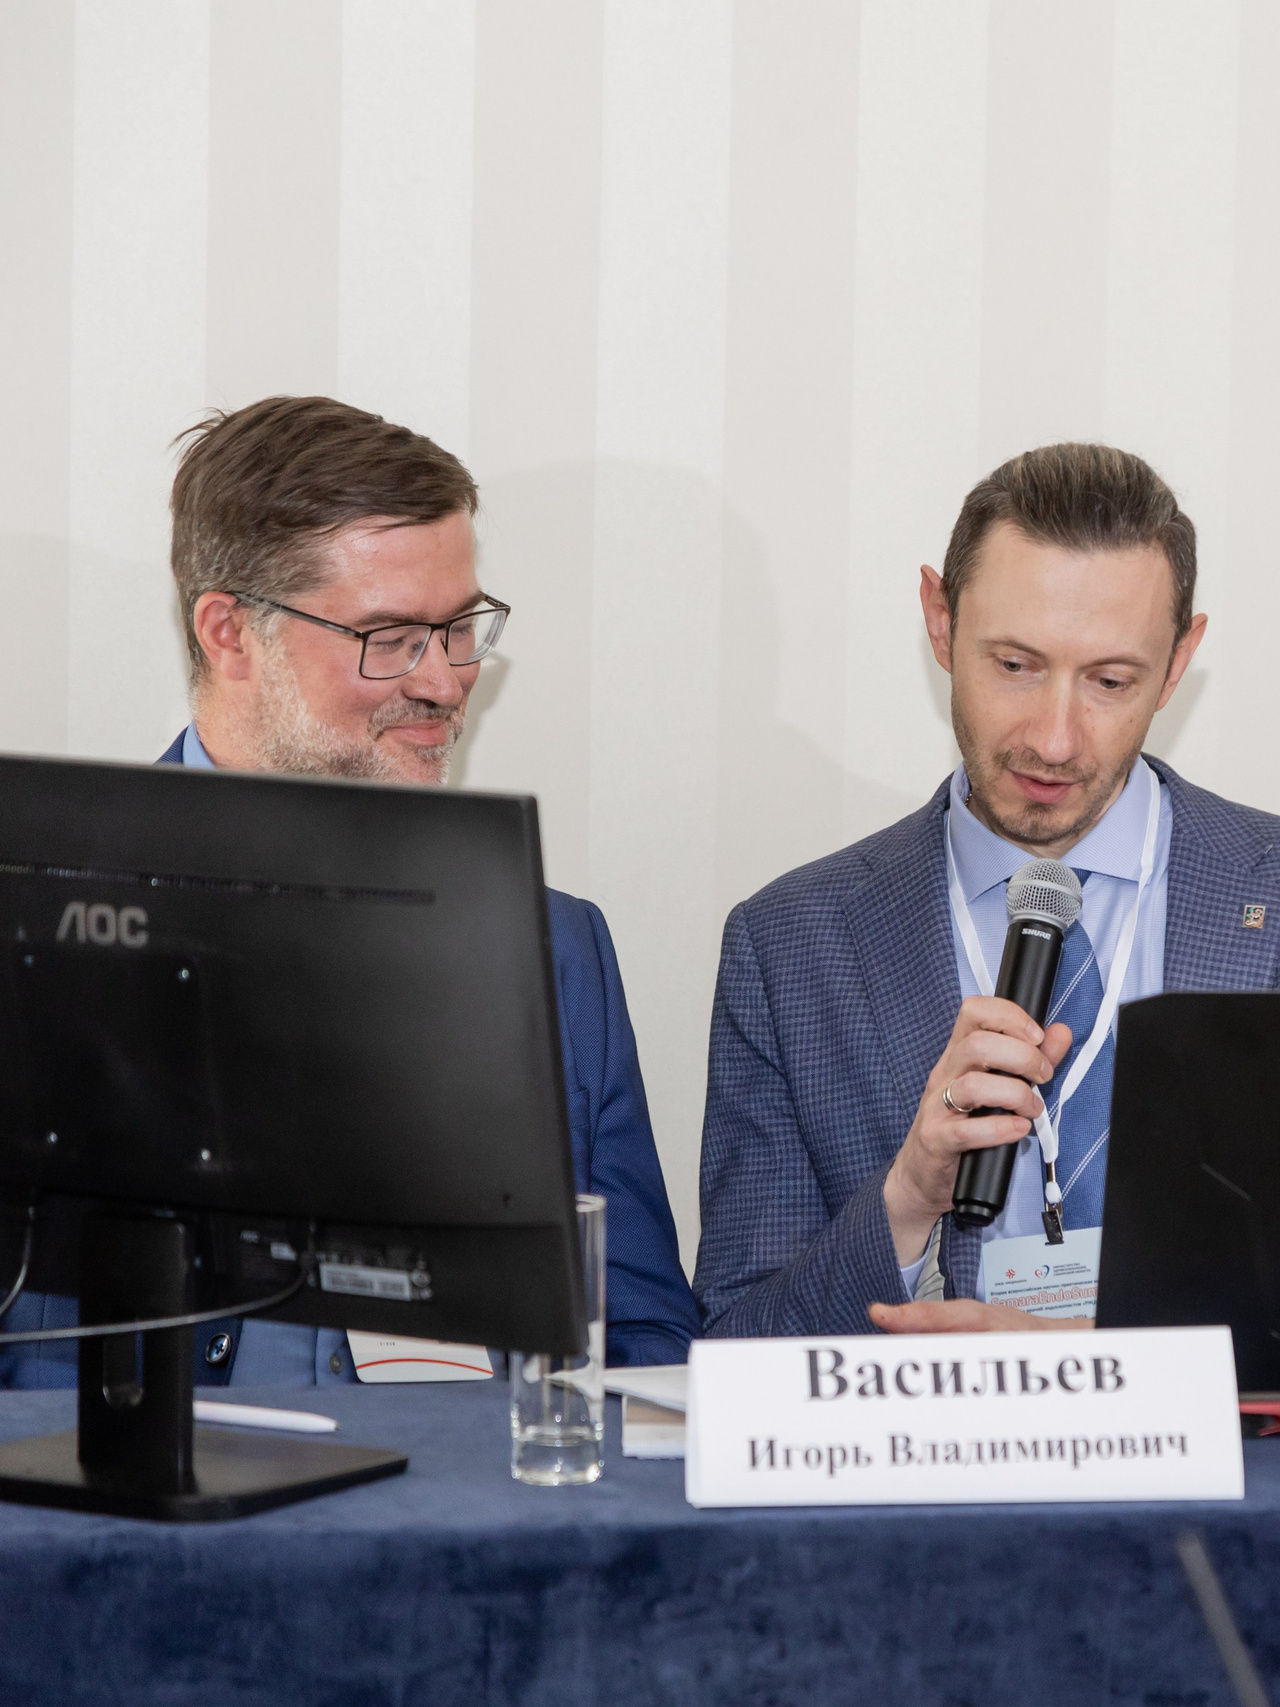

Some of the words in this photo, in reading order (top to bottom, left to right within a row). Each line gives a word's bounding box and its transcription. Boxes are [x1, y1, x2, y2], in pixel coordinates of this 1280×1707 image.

[56, 901, 149, 948] AOC
[1021, 928, 1051, 940] SHURE
[990, 1286, 1098, 1309] SamaraEndoSum
[804, 1347, 1127, 1402] Васильев
[747, 1437, 873, 1478] Игорь
[887, 1433, 1190, 1470] Владимирович
